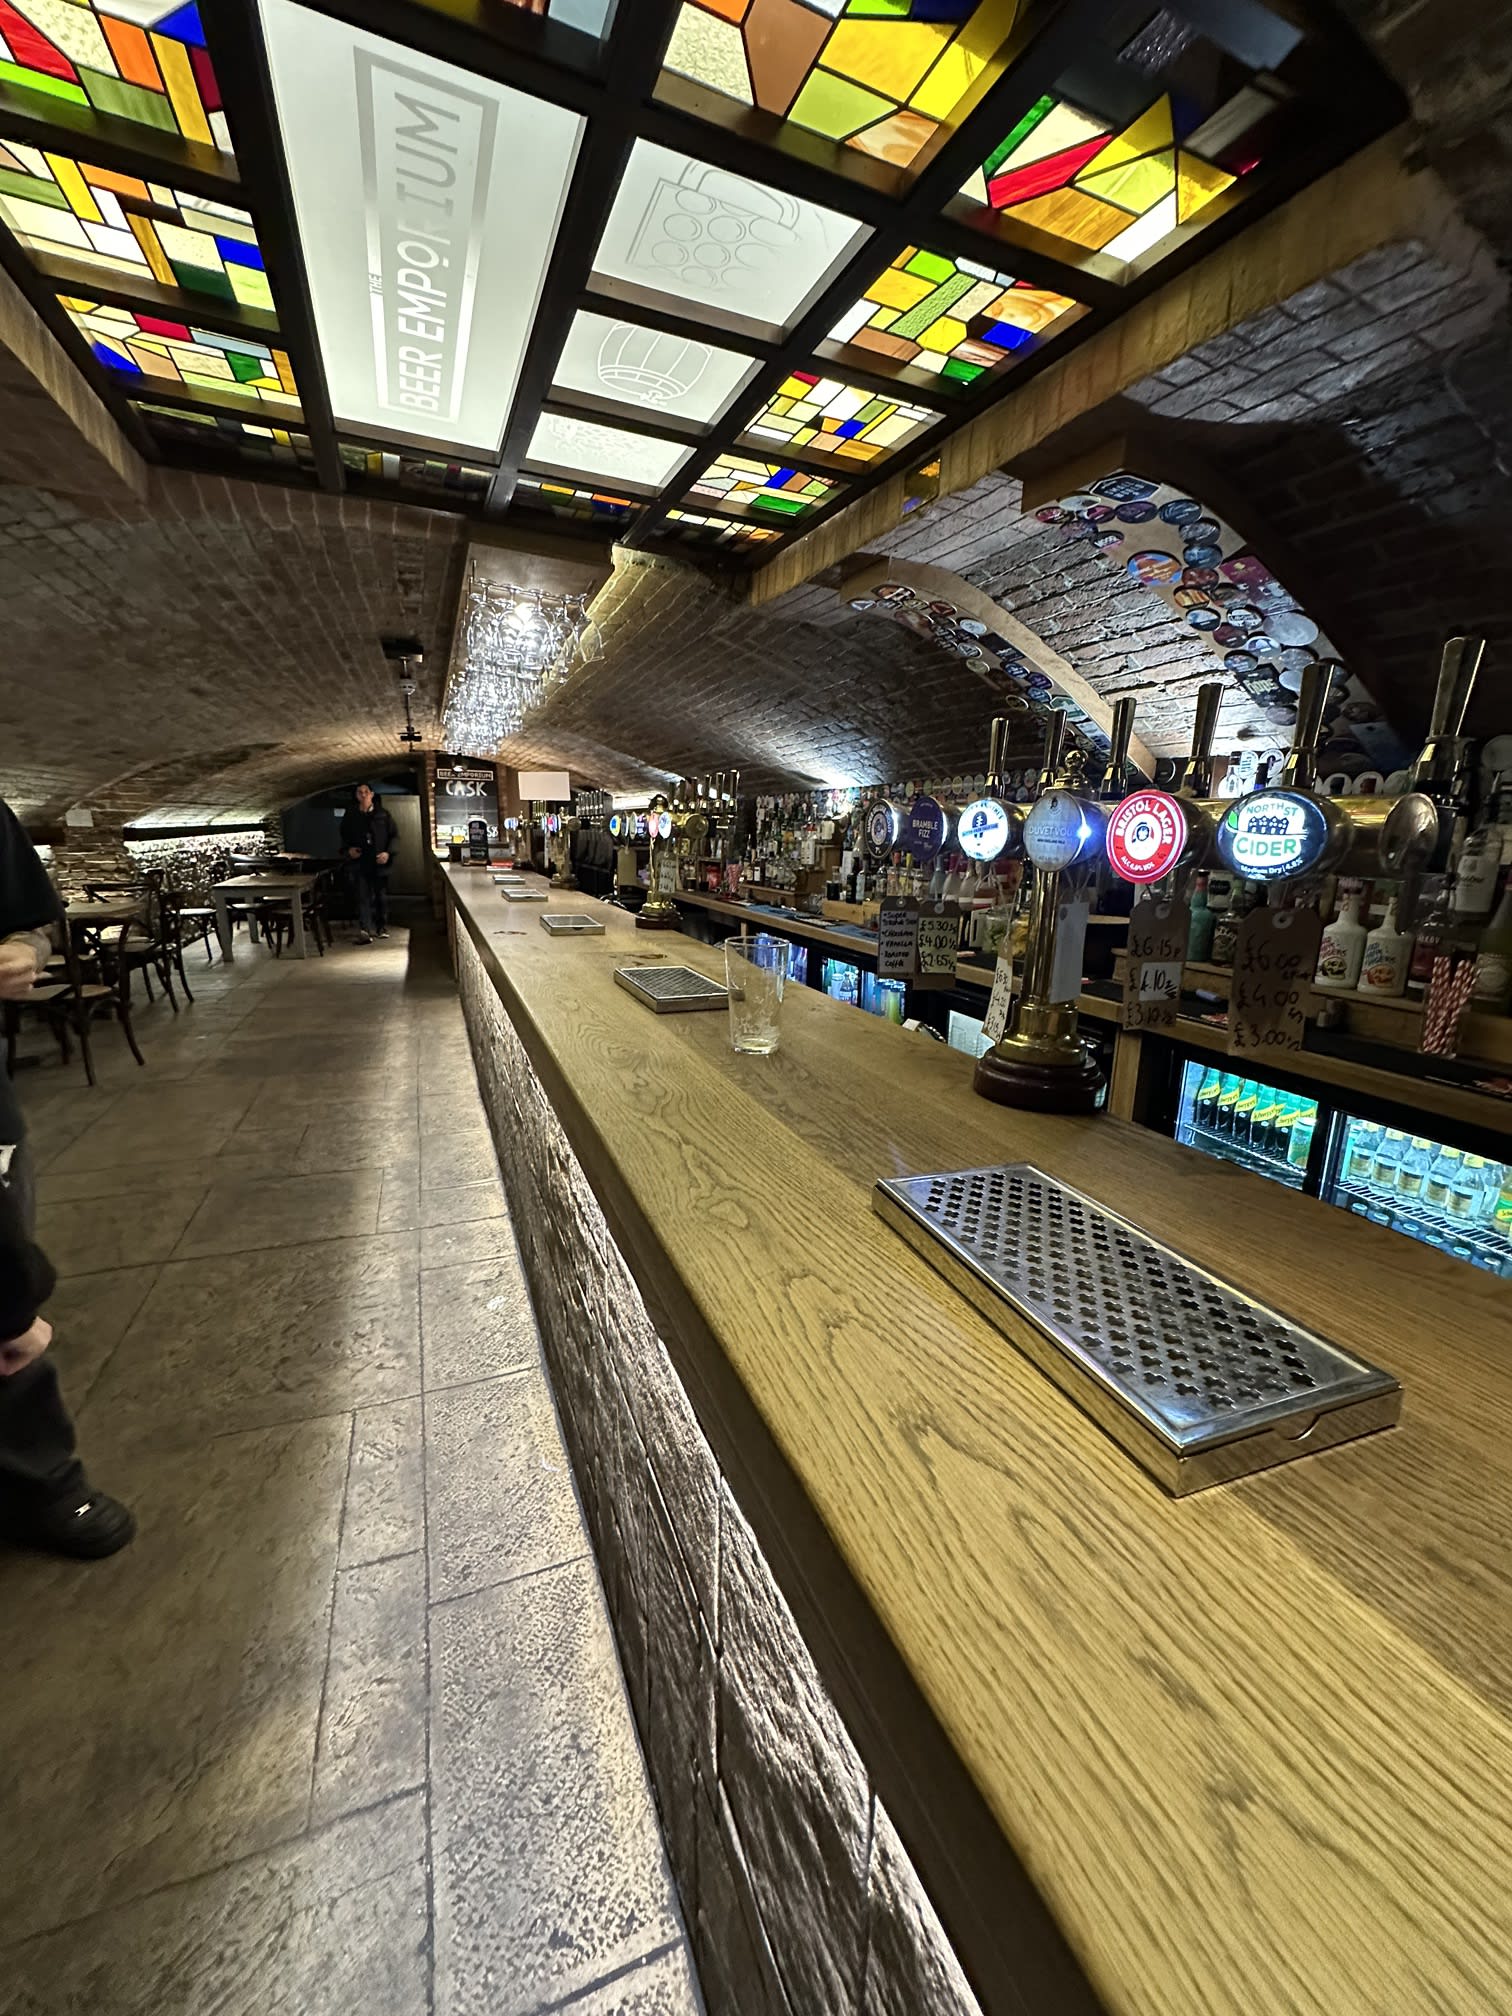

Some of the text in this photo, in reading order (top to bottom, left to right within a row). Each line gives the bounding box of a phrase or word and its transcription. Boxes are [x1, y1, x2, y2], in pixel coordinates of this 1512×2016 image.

[369, 273, 383, 297] THE
[398, 346, 443, 412] BEER
[446, 780, 487, 797] CASK
[1246, 802, 1299, 816] NORTH ST
[912, 819, 939, 831] BRAMBLE
[1115, 799, 1174, 845] BRISTOL LAGER
[918, 829, 930, 838] FIZZ
[1236, 837, 1297, 857] CIDER
